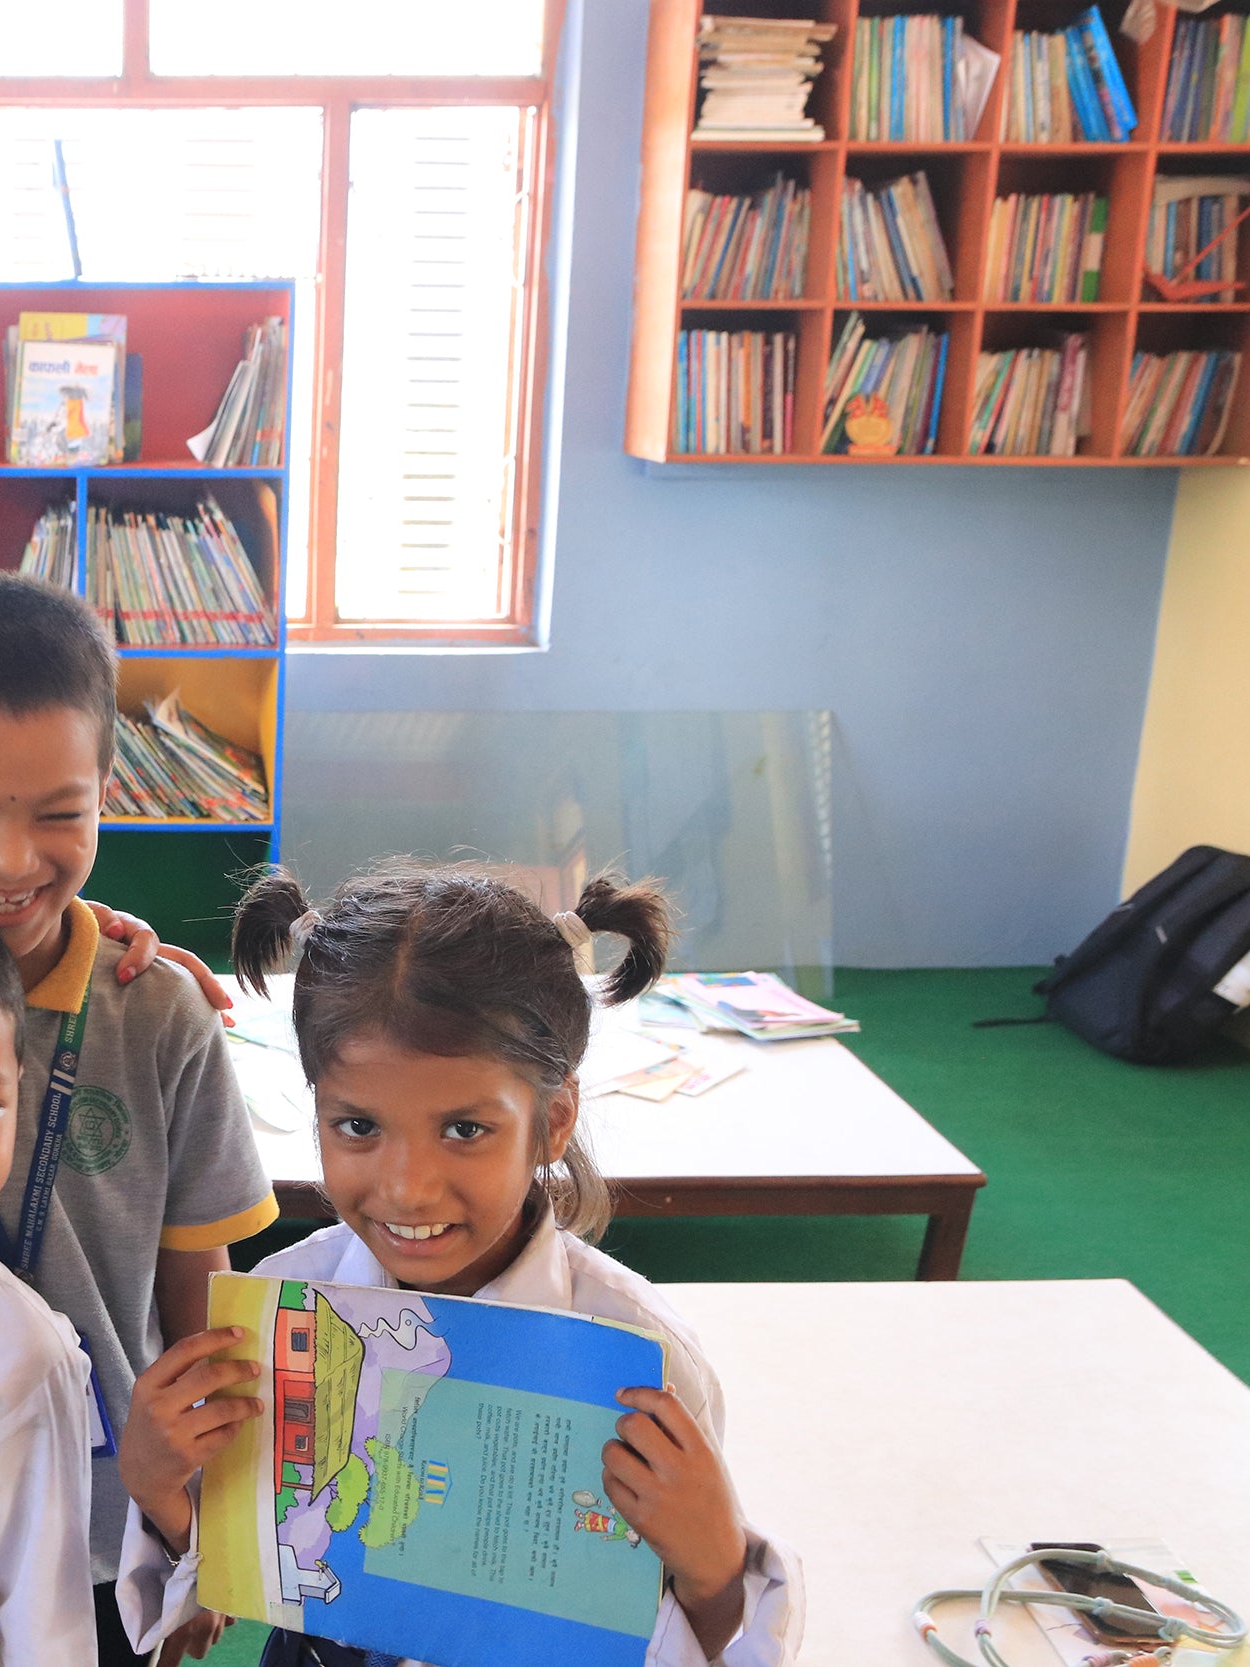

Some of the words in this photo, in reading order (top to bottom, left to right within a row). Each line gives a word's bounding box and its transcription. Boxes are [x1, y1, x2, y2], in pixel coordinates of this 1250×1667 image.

[48, 1092, 61, 1128] SCHOOL
[52, 1134, 62, 1160] GORKHA
[36, 1129, 54, 1184] SECONDARY
[25, 1186, 41, 1238] MAHALAXMI
[21, 1239, 31, 1269] SHREE
[400, 1406, 408, 1425] World
[476, 1402, 484, 1420] these
[515, 1409, 521, 1420] We
[397, 1425, 406, 1449] Change
[474, 1420, 482, 1439] pots?
[511, 1432, 519, 1448] pots,
[396, 1450, 404, 1469] Starts
[419, 1459, 427, 1477] Room
[509, 1464, 515, 1473] we
[395, 1470, 403, 1483] with
[480, 1474, 486, 1484] Do
[508, 1474, 515, 1484] do
[392, 1484, 401, 1514] Educated
[484, 1508, 492, 1526] helps
[493, 1526, 499, 1534] to
[498, 1576, 504, 1584] to
